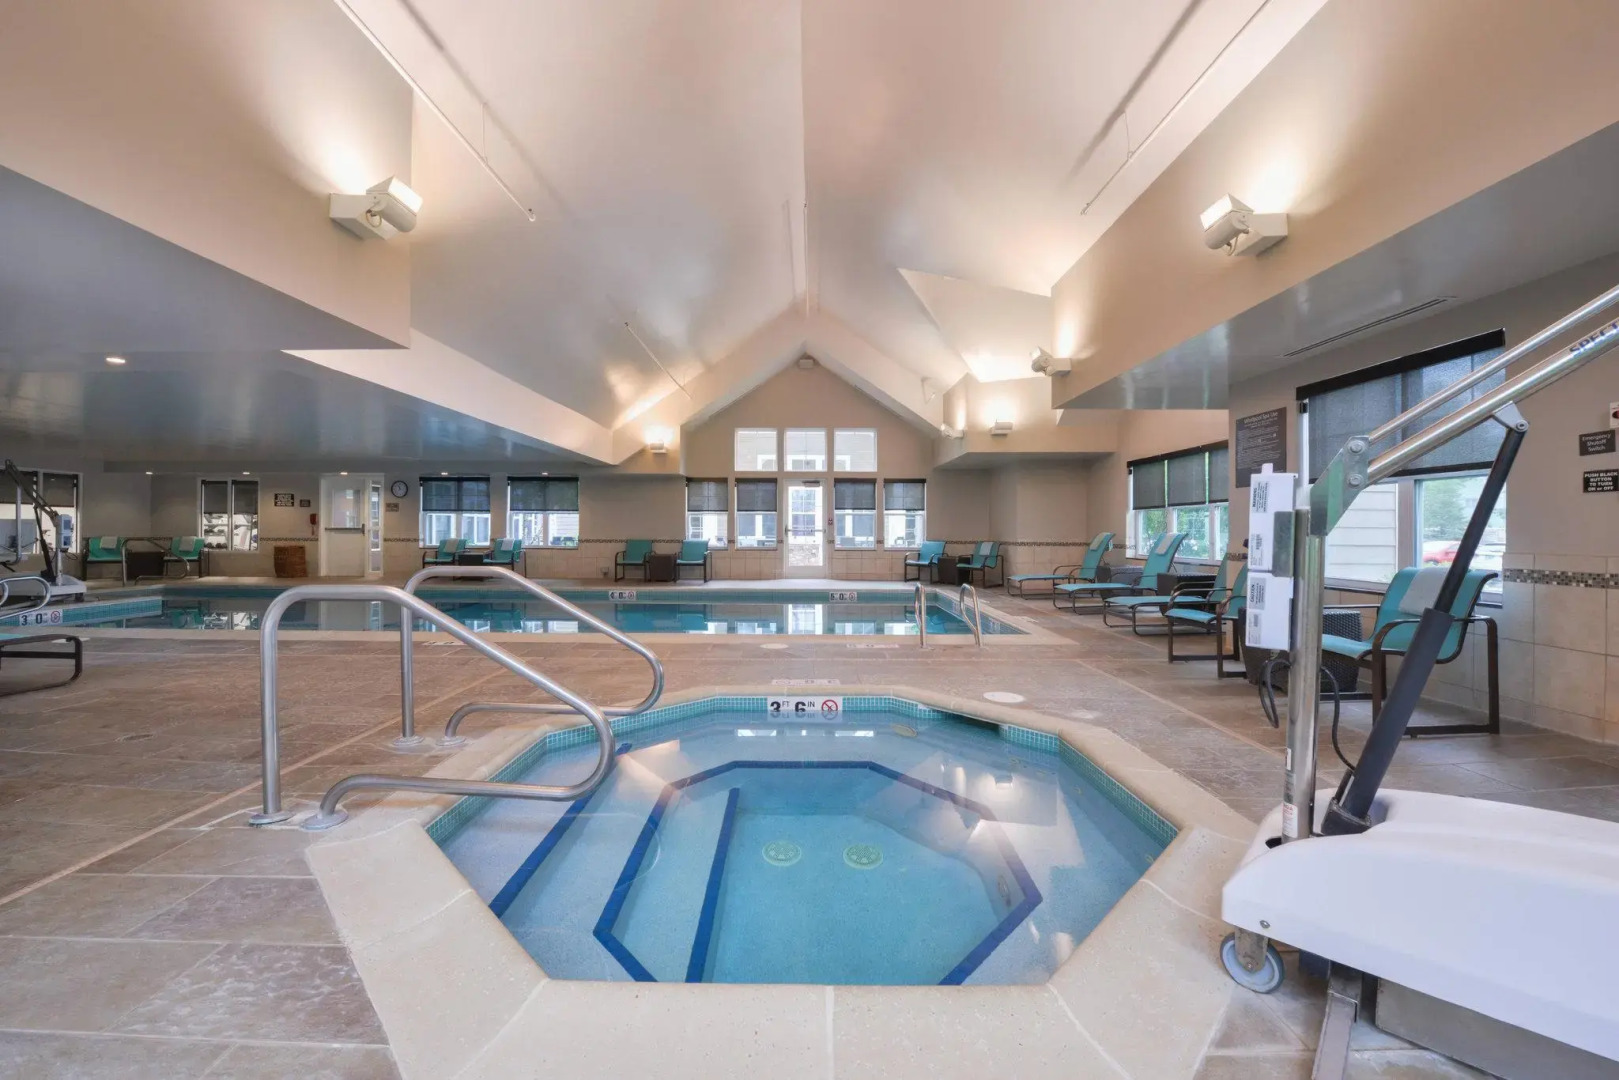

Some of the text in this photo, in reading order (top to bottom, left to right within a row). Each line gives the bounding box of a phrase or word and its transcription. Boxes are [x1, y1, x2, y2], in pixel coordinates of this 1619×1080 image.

[1582, 433, 1611, 441] Emergency
[21, 614, 28, 626] 3
[35, 613, 43, 624] 0
[770, 701, 781, 712] 3
[795, 701, 806, 712] 6
